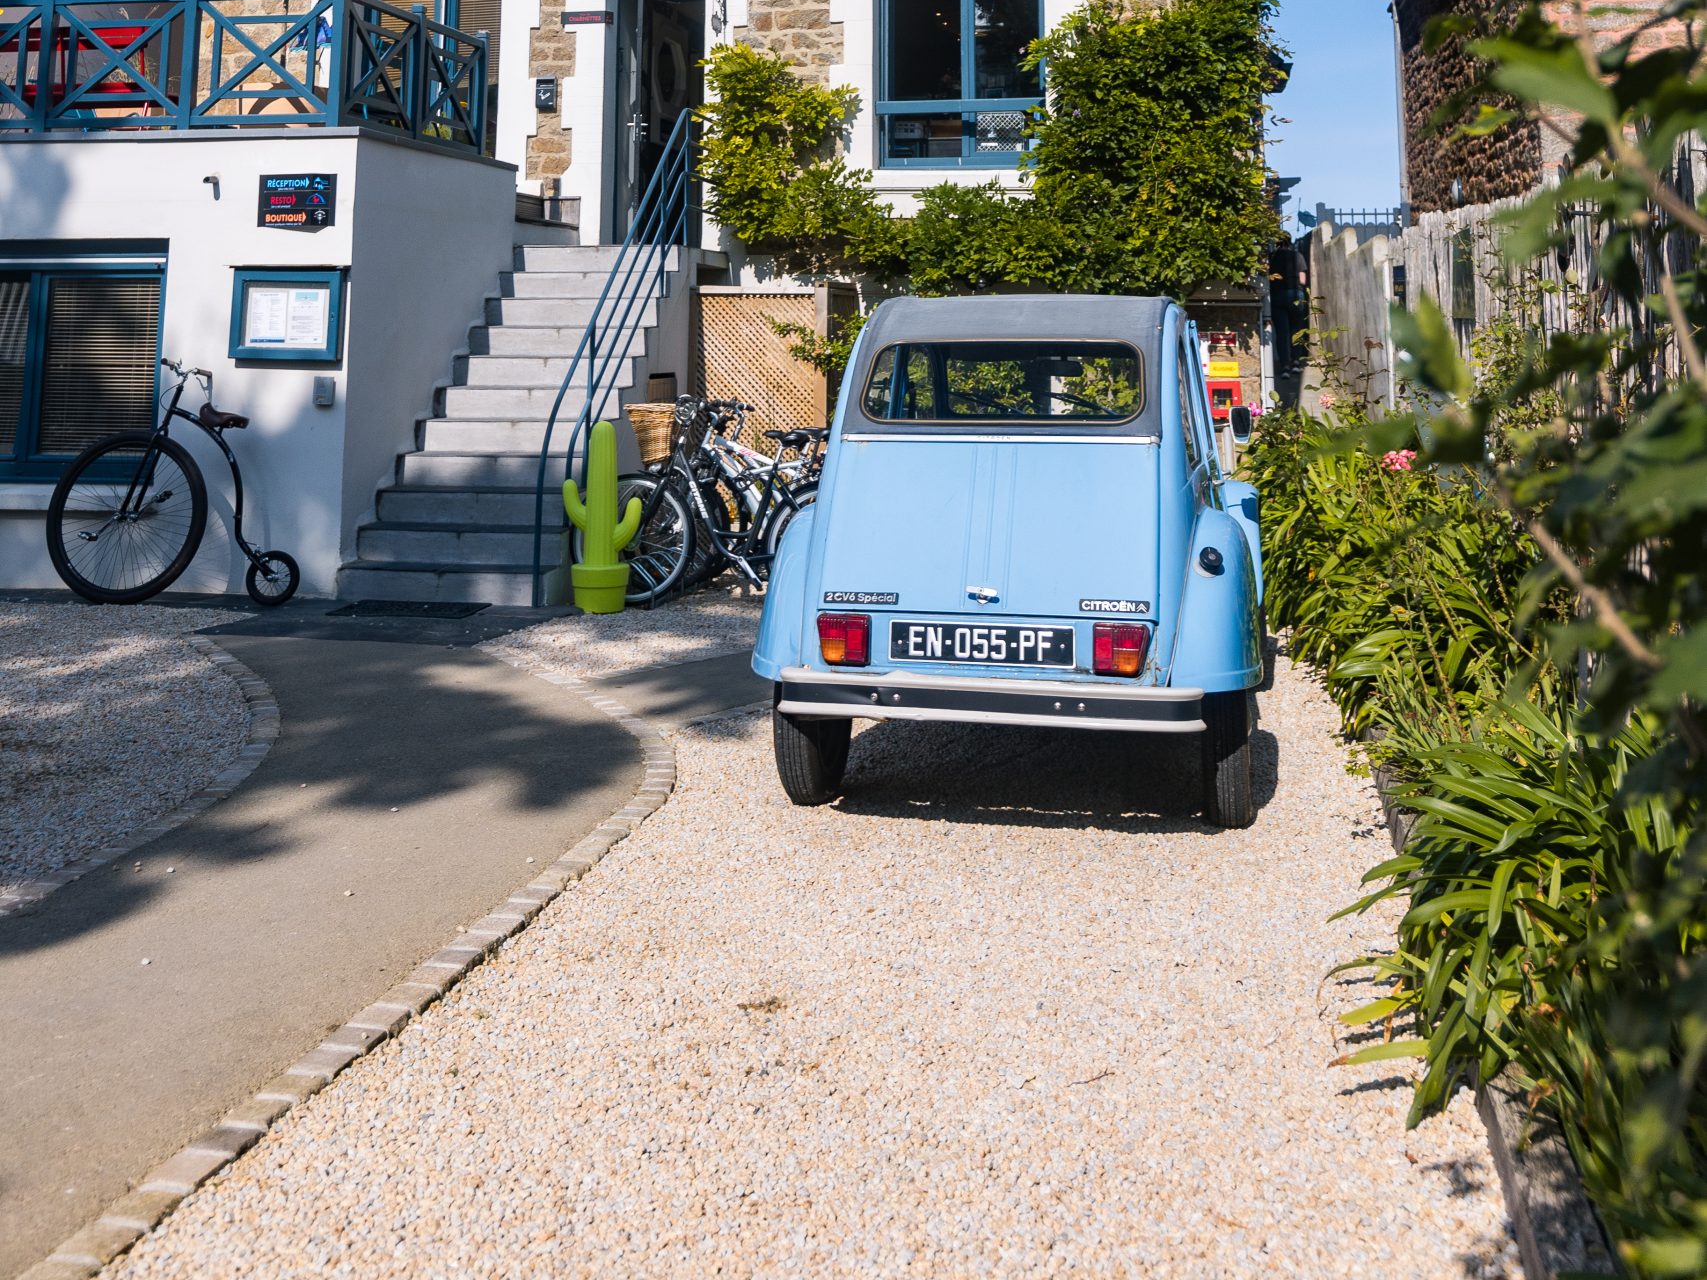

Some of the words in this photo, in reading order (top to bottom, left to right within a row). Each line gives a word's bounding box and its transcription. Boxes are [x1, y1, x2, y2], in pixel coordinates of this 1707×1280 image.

[267, 179, 306, 188] RÉCEPTION
[270, 195, 292, 205] RESTO
[265, 213, 303, 222] BOUTIQUE
[857, 593, 896, 604] Spécial
[1081, 599, 1136, 612] CITROËN
[908, 625, 1054, 662] EN-055-PF
